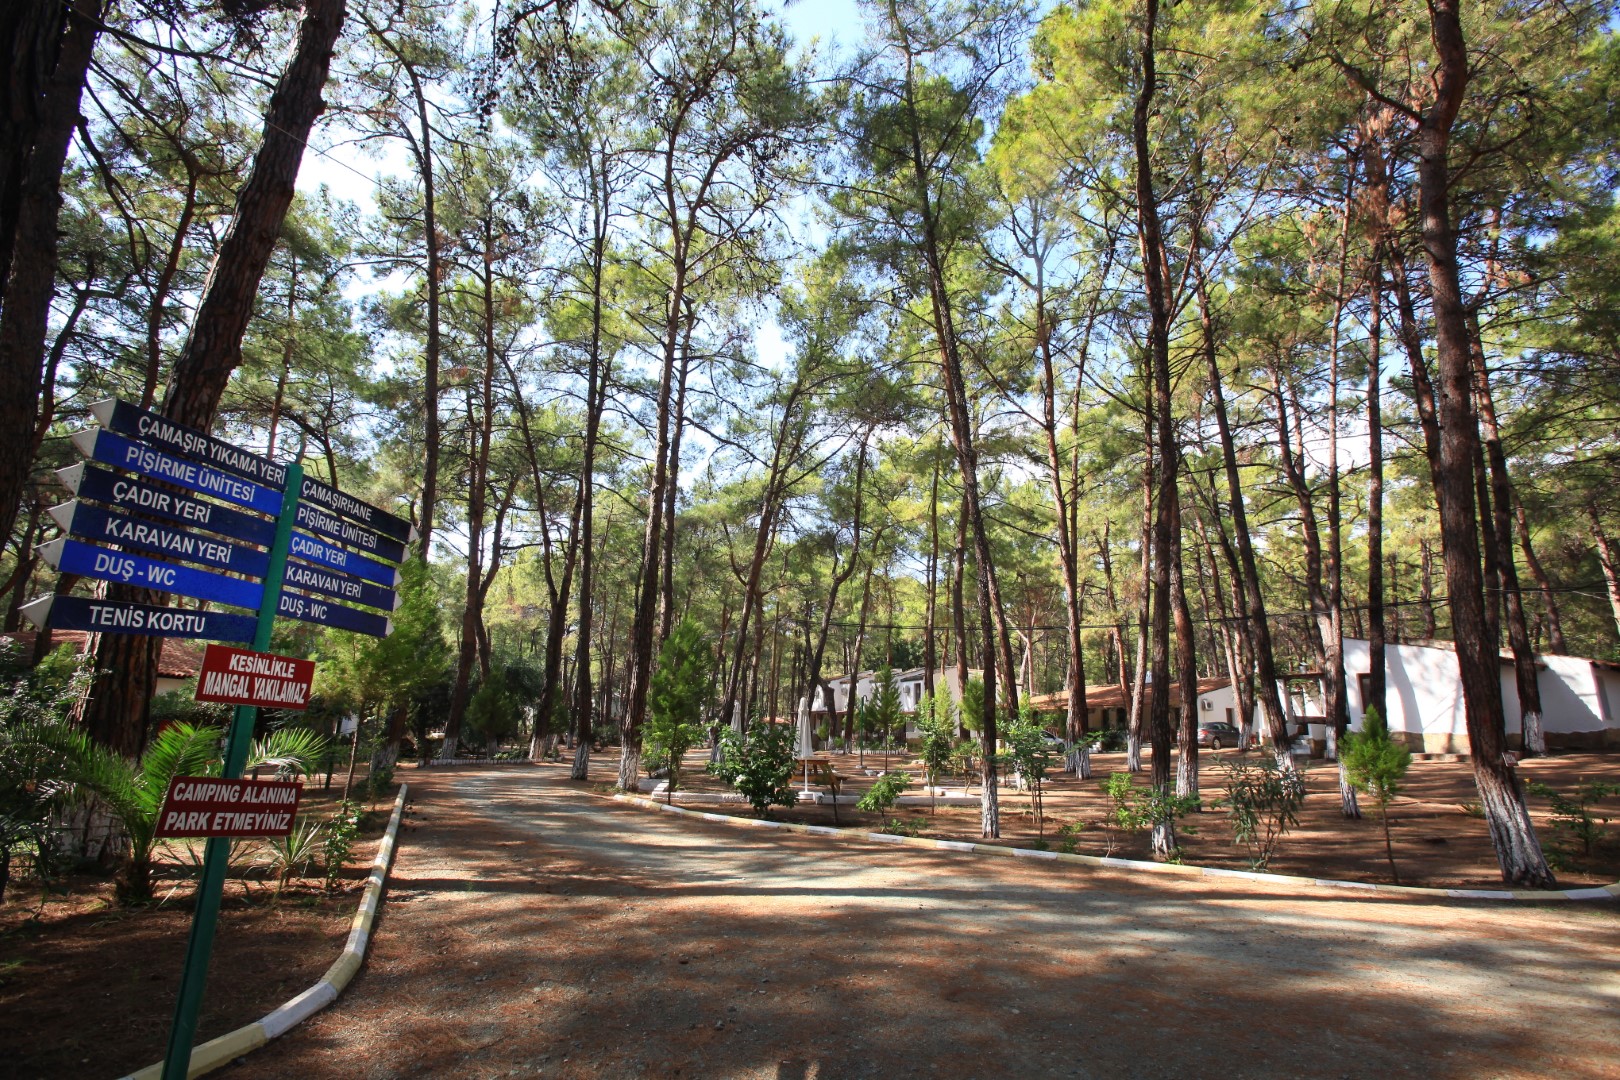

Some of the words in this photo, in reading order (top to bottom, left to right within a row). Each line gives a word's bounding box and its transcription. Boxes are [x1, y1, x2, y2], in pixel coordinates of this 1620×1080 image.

[138, 415, 207, 456] ÇAMAŞIR
[209, 442, 257, 475] YIKAMA
[260, 462, 287, 485] YERİ
[126, 445, 197, 483] PİŞİRME
[198, 467, 256, 503] ÜNİTESİ
[113, 481, 170, 512] ÇADIR
[174, 498, 212, 524] YERİ
[302, 480, 373, 521] ÇAMAŞIRHANE
[105, 517, 195, 554] KARAVAN
[197, 540, 233, 564] YERİ
[297, 507, 341, 535] PİŞİRME
[341, 522, 378, 549] ÜNİTESİ
[291, 536, 324, 559] ÇADIR
[325, 547, 348, 567] YERİ
[94, 553, 135, 582] DUŞ
[147, 564, 176, 586] WC
[286, 565, 339, 592] KARAVAN
[340, 580, 362, 598] YERİ
[89, 605, 145, 628] TENİS
[147, 611, 206, 633] KORTU
[280, 595, 304, 617] DUŞ
[310, 602, 328, 620] WC
[228, 653, 296, 679] KESİNLİKLE
[202, 671, 250, 699] MANGAL
[252, 676, 308, 704] YAKILAMAZ
[173, 782, 241, 803] CAMPING
[241, 786, 297, 804] ALANINA
[163, 811, 212, 831] PARK
[212, 809, 291, 830] ETMEYİNİZ
